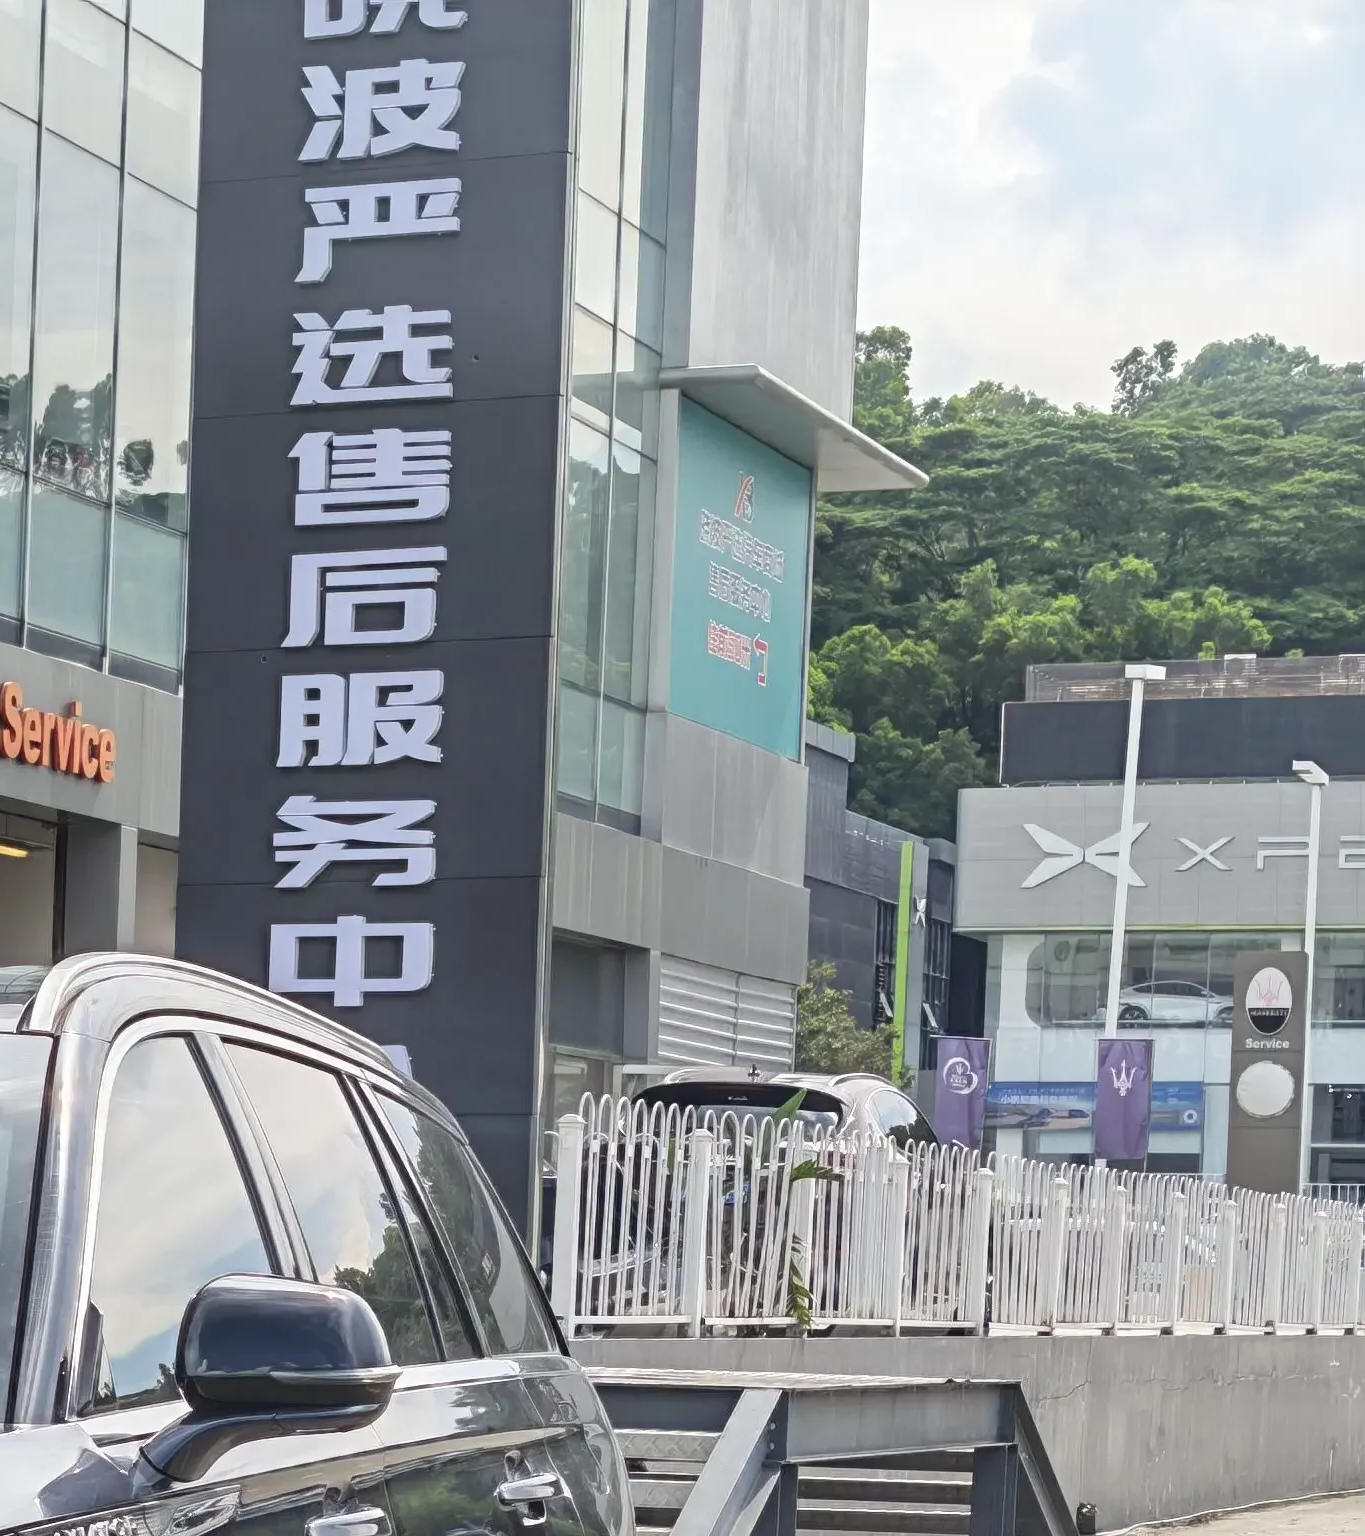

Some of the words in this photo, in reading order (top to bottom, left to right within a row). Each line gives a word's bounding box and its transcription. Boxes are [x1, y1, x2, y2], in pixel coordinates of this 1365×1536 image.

[269, 0, 468, 1080] 波严选售后服务中
[1245, 1037, 1290, 1049] Service
